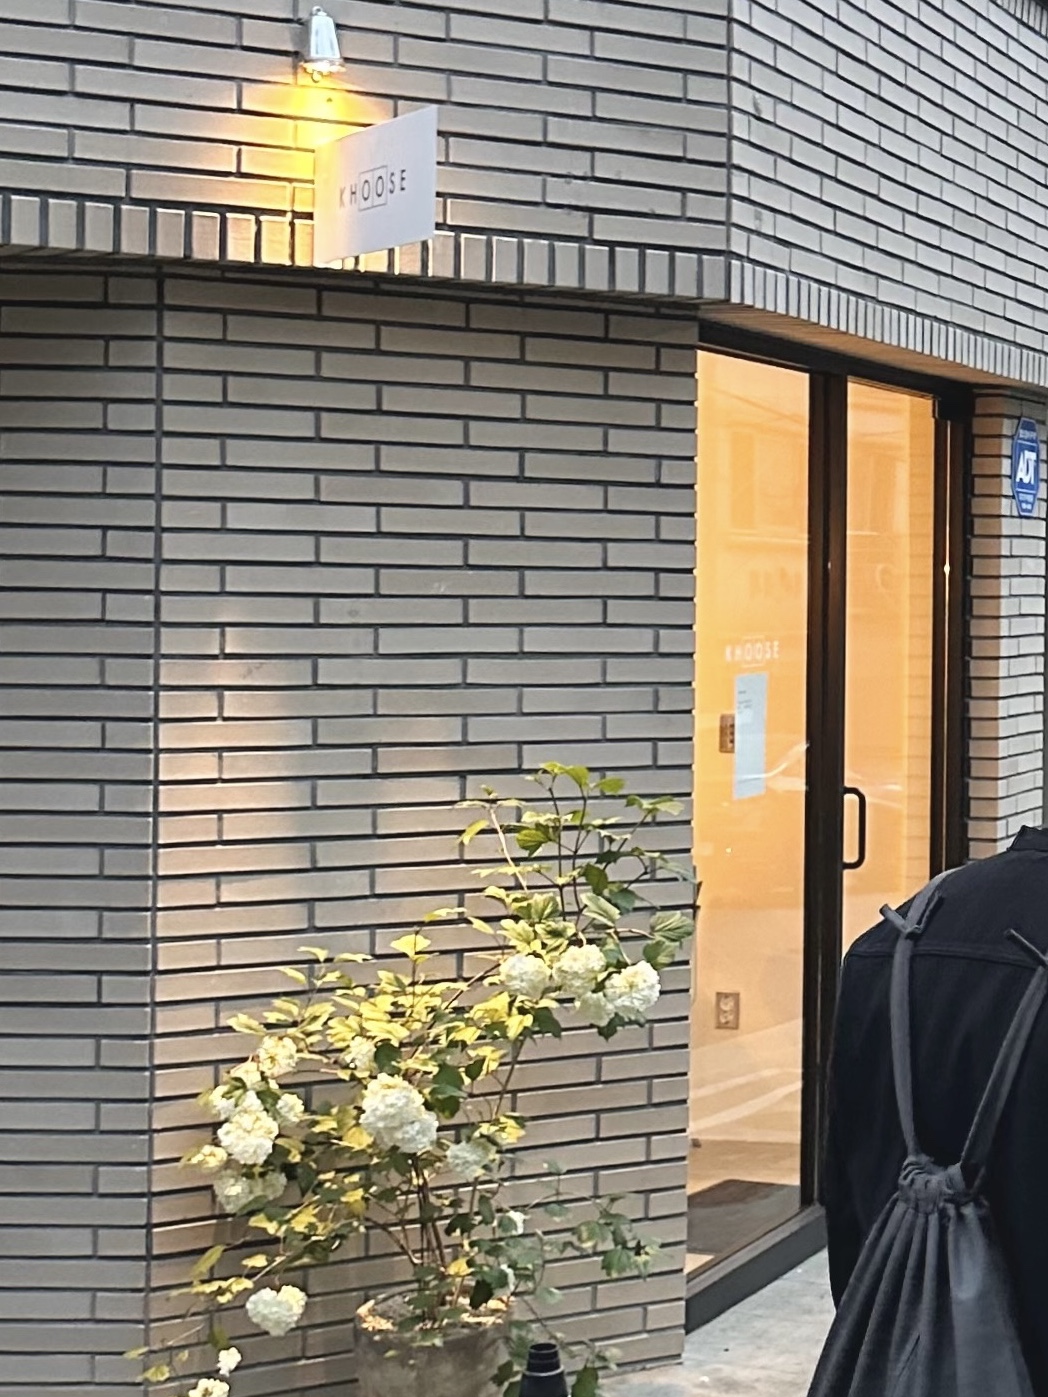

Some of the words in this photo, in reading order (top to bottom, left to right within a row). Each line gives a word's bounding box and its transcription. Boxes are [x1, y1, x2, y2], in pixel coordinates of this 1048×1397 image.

[339, 169, 406, 208] KHOOSE
[1016, 449, 1037, 485] ADT
[725, 640, 779, 662] KHOOSE
